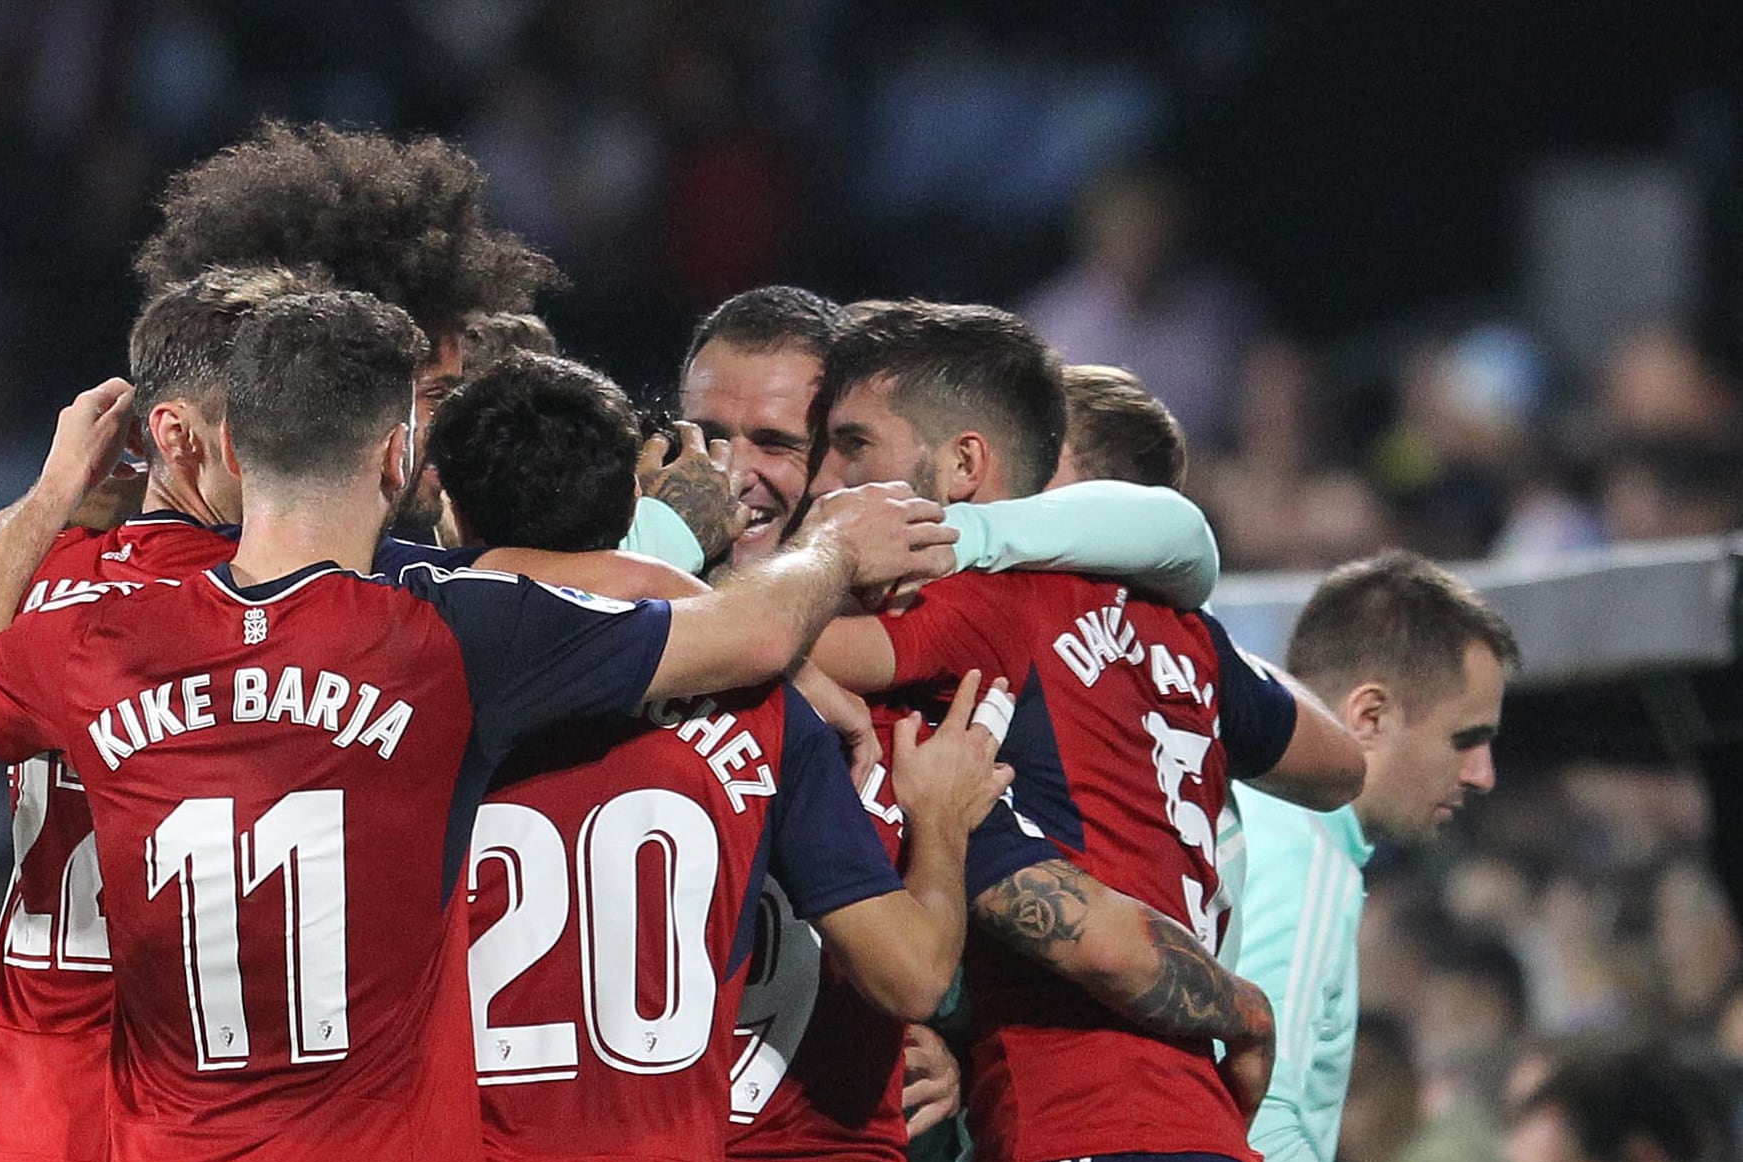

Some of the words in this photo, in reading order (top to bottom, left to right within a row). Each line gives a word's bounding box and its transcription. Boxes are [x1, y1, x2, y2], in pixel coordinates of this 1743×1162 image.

[87, 673, 216, 770] KIKE
[233, 666, 415, 761] BARJA
[642, 695, 777, 815] CHEZ
[145, 789, 349, 1071] 11
[467, 788, 719, 1086] 20
